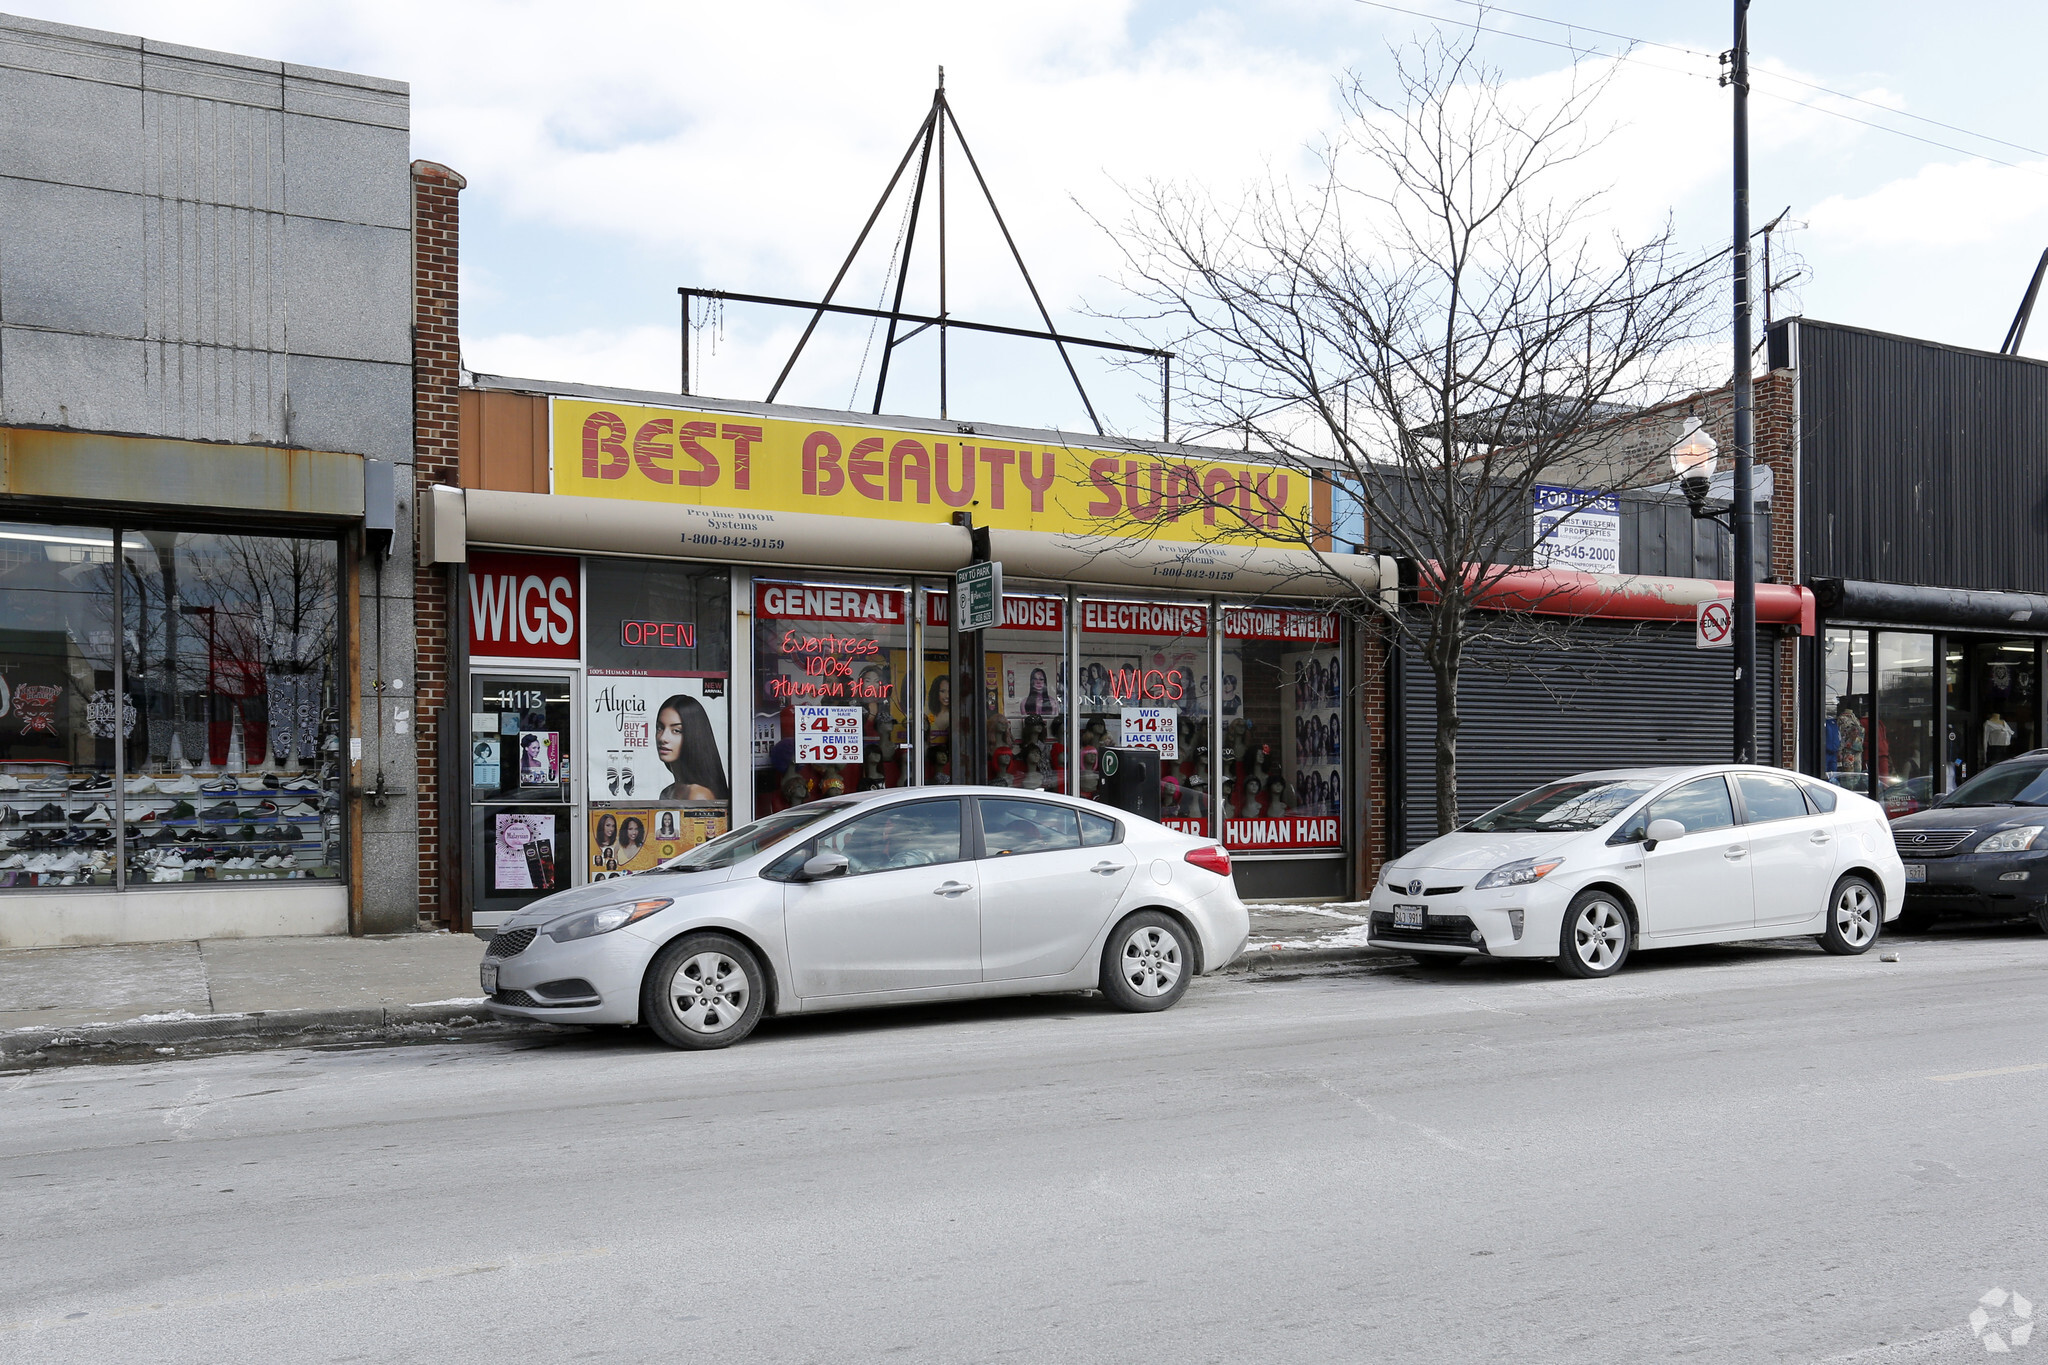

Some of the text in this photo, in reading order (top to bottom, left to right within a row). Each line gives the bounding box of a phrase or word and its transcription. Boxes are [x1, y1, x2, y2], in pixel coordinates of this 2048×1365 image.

[582, 411, 1289, 531] BEST BEAUTY SUPPLY
[1540, 490, 1567, 507] FOR
[687, 509, 775, 522] Pro line DOOR
[707, 518, 758, 531] Systems
[680, 532, 785, 550] 1-800-842-9159
[1540, 543, 1616, 562] 773-545-2000
[959, 566, 990, 582] PAY TO PARK
[1152, 567, 1234, 581] 1-800-842-9159
[468, 573, 575, 645] WIGS
[764, 587, 898, 619] GENERAL
[1085, 603, 1202, 633] ELECTRONICS
[1225, 611, 1336, 639] CUSTOME JEWELRY
[624, 622, 693, 647] OPEN
[782, 629, 879, 655] Evertress
[806, 656, 853, 677] 100%
[704, 682, 723, 690] NEW
[770, 674, 894, 698] Human Hair
[1108, 669, 1184, 701] WIGS
[498, 690, 543, 709] 11113
[595, 684, 646, 732] Alycia
[800, 708, 829, 716] YAKI
[1140, 709, 1160, 717] WIG
[623, 722, 649, 738] BUY 1
[623, 730, 639, 738] GET
[822, 735, 846, 744] REMI
[623, 738, 649, 747] FREE
[1226, 819, 1338, 844] HUMAN HAIR
